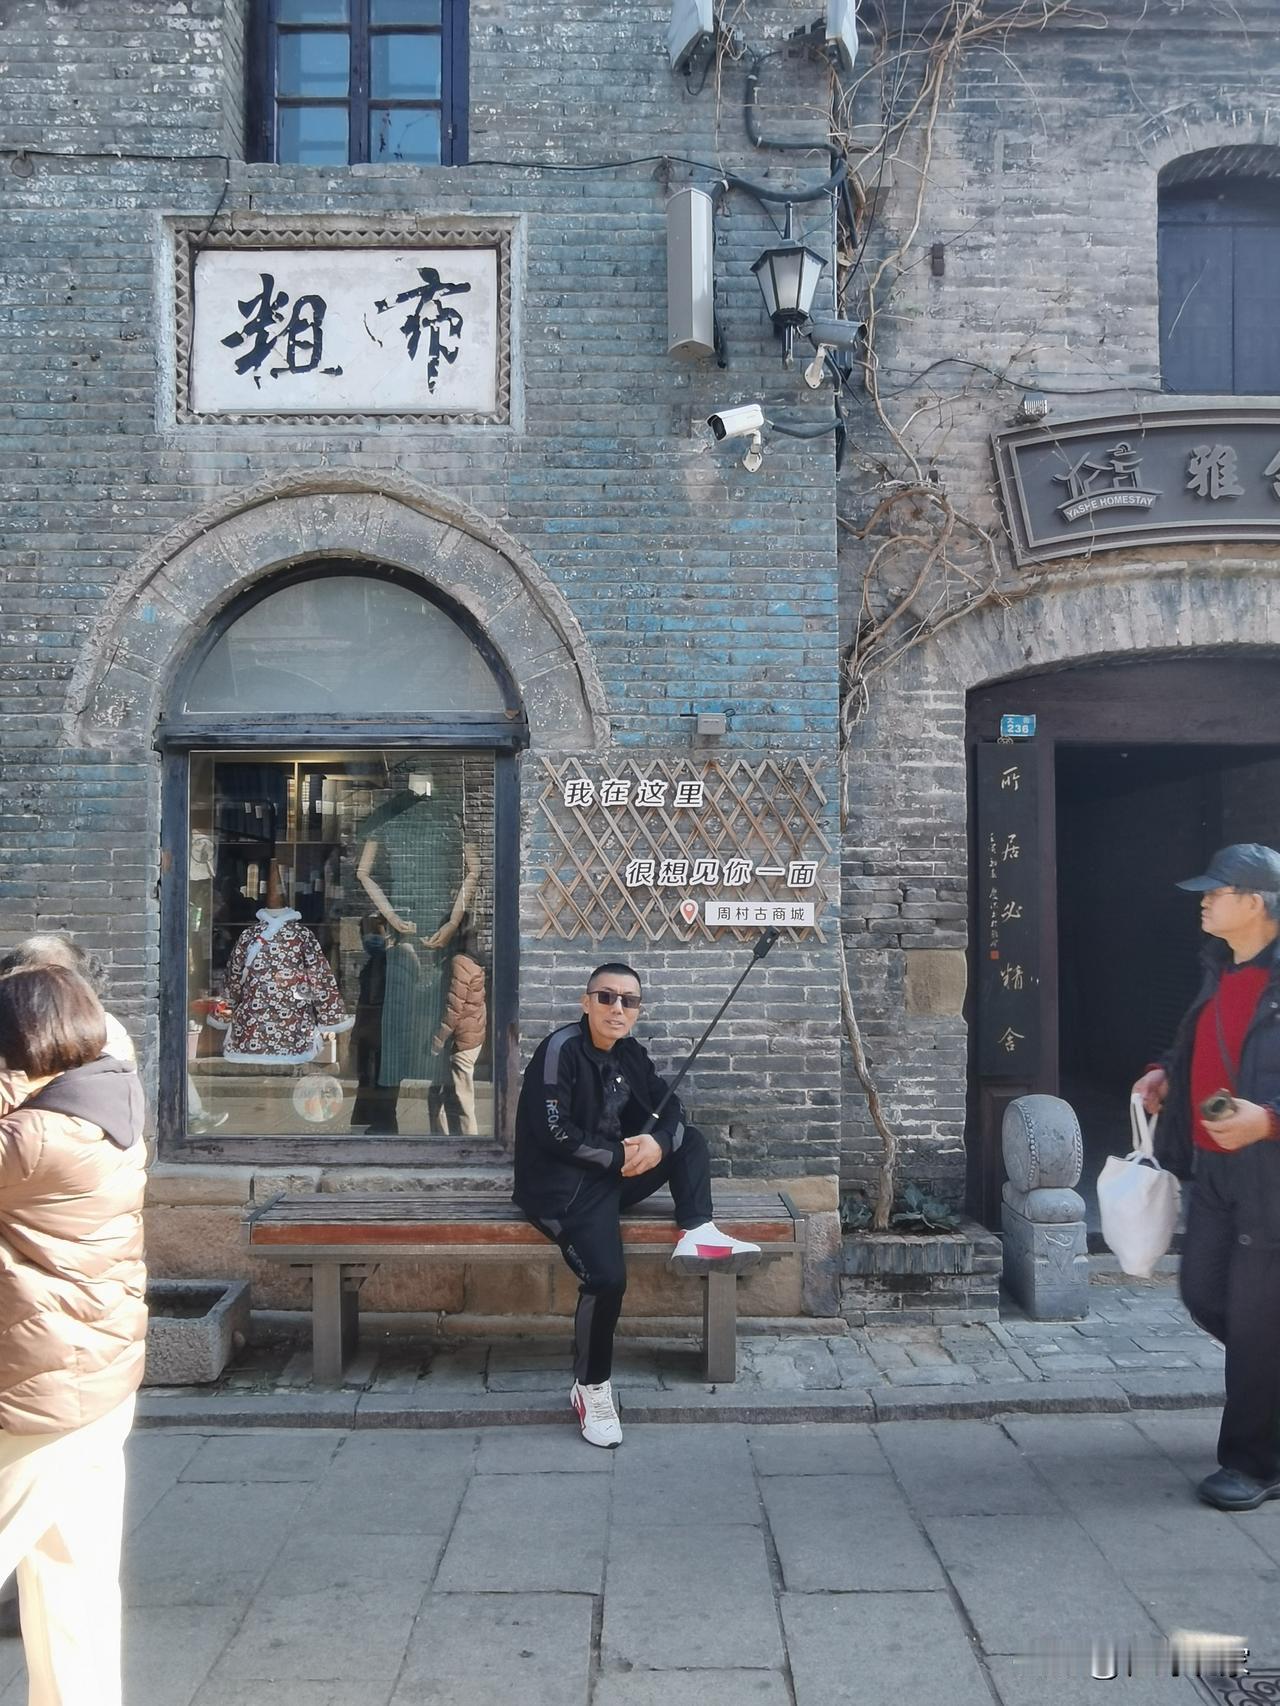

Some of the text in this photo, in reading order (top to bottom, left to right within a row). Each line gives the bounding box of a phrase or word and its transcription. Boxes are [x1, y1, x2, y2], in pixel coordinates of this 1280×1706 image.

[1066, 495, 1154, 519] YASHE HOMESTAY
[1007, 724, 1029, 734] 236
[564, 779, 705, 808] 我在这里
[625, 858, 819, 887] 很想见你一面
[717, 906, 806, 922] 周村古商城
